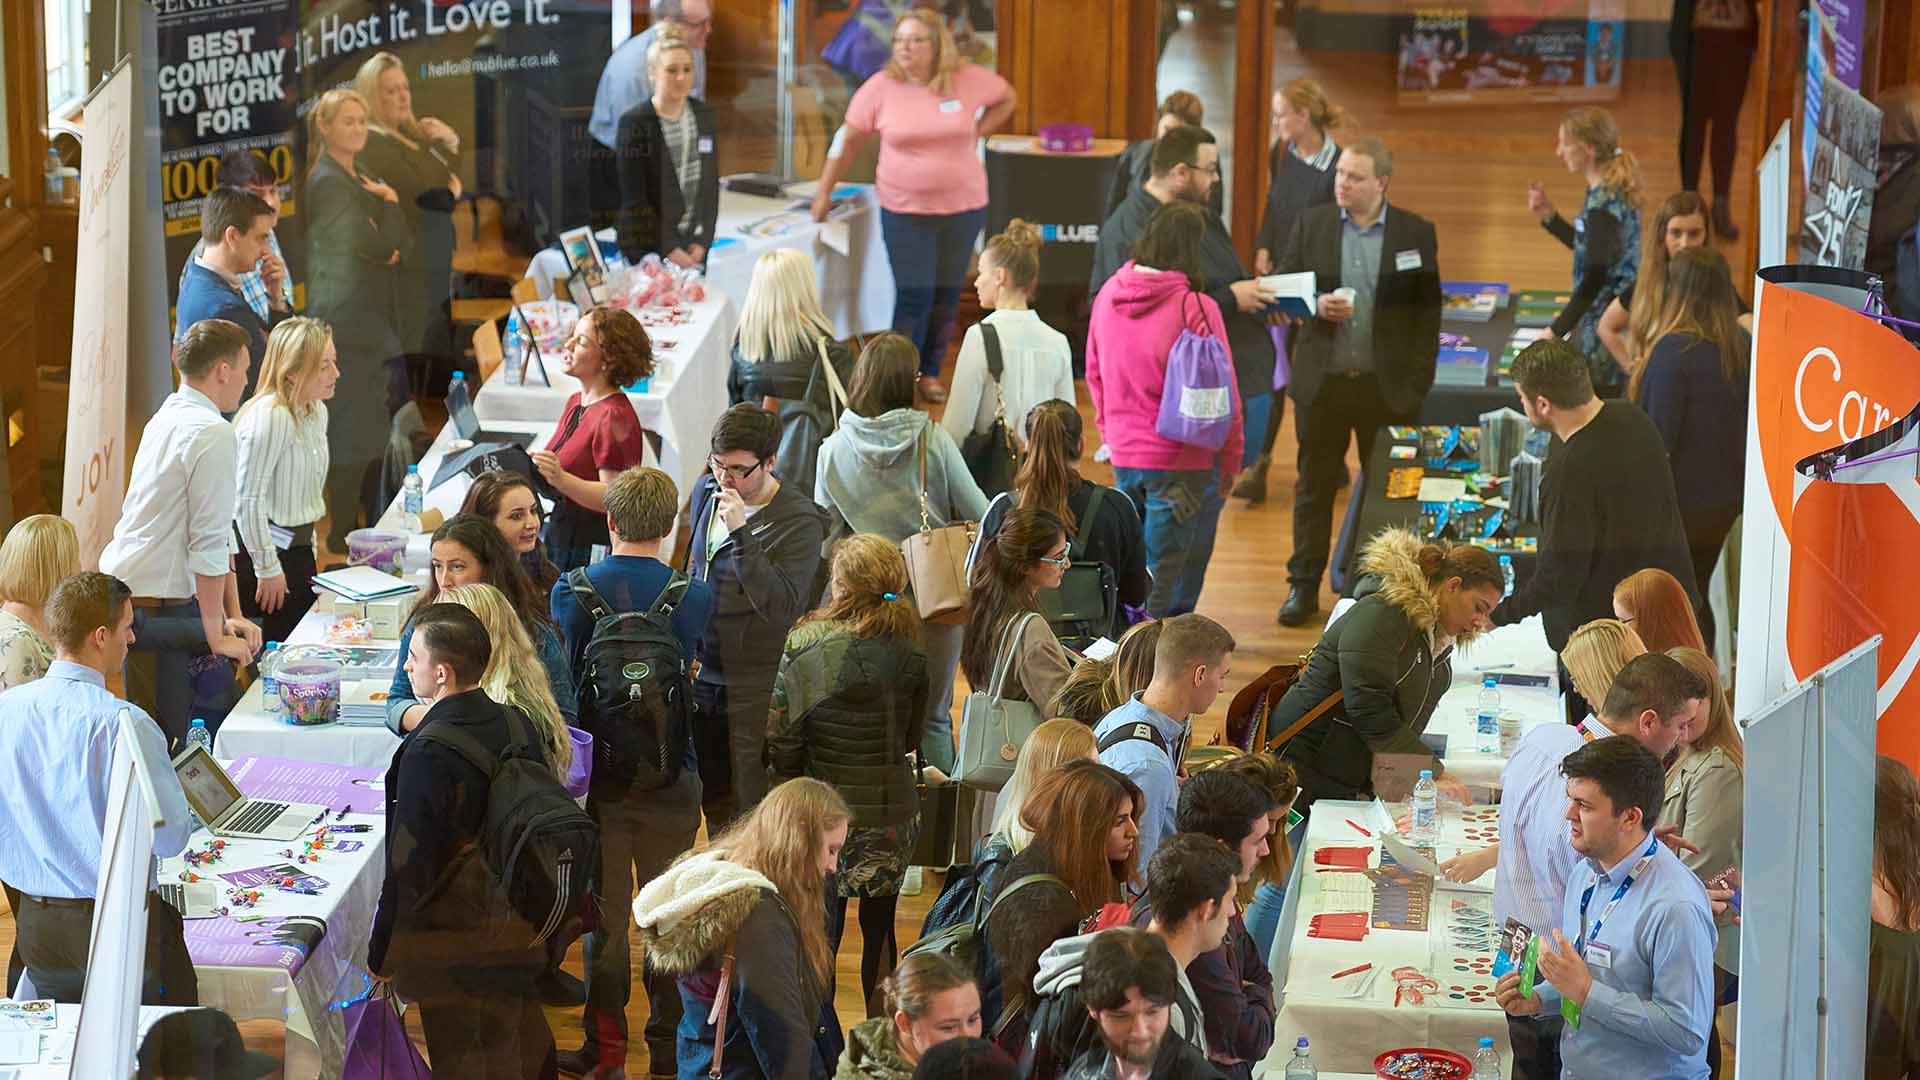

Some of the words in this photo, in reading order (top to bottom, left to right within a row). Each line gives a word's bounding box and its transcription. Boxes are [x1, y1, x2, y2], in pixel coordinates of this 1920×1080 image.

[187, 27, 255, 61] BEST
[320, 12, 381, 59] Host
[389, 3, 417, 41] it.
[425, 0, 511, 34] Love
[159, 48, 286, 91] COMPANY
[428, 49, 560, 78] hello@nublue.co.uk
[161, 88, 197, 117] TO
[203, 74, 285, 109] WORK
[197, 106, 250, 137] FOR
[162, 154, 220, 204] 100
[1034, 224, 1099, 242] BLUE
[1795, 347, 1900, 443] Car
[76, 437, 115, 507] JOY
